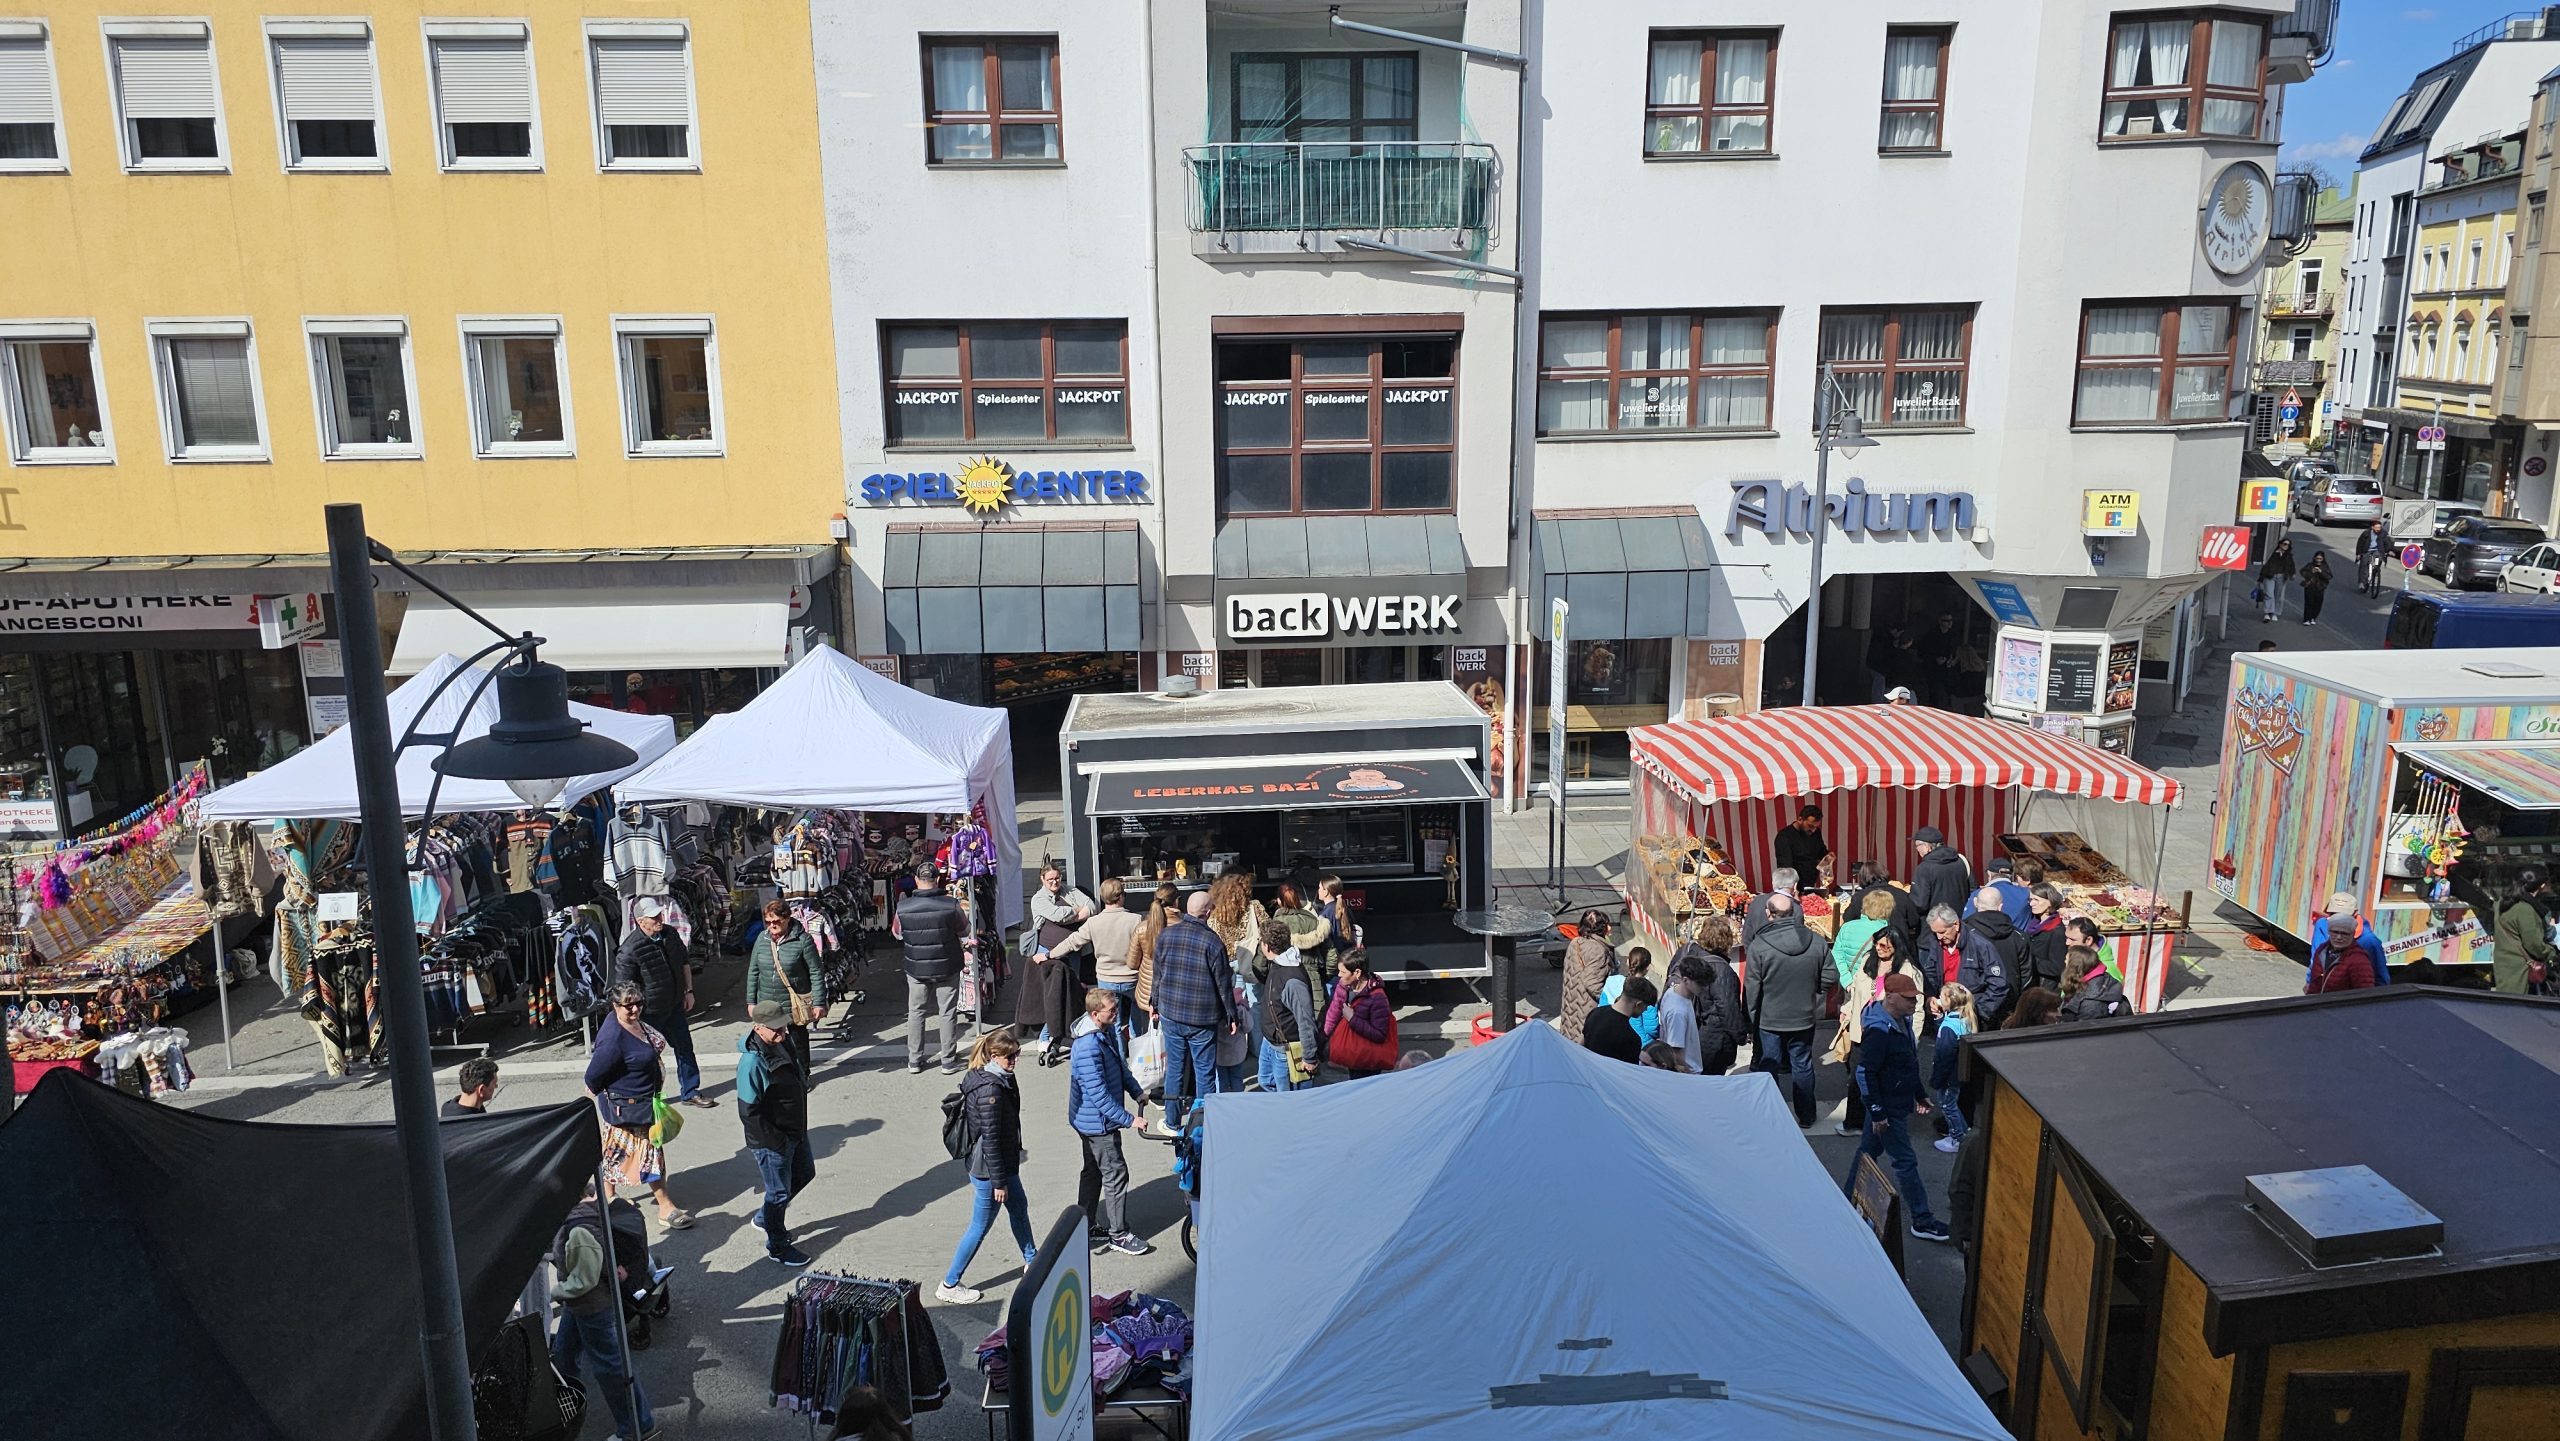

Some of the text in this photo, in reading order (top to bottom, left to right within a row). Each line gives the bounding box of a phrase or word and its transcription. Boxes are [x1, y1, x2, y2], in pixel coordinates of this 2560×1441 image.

[895, 390, 1121, 405] JACKPOT Spielcenter JACKPOT
[1224, 390, 1449, 406] JACKPOT Spielcenter JACKPOT
[1619, 402, 1657, 419] Juwelier
[1892, 396, 1960, 413] Juwelier Bacak
[861, 470, 1146, 500] SPIEL CENTER
[1724, 477, 1974, 535] Atrium
[2100, 495, 2131, 505] ATM
[2407, 510, 2421, 520] 20
[2203, 532, 2246, 566] illy
[2093, 554, 2104, 562] 34
[1457, 651, 1485, 660] back
[1711, 645, 1738, 655] back
[864, 660, 893, 670] back
[1184, 656, 1211, 665] back
[1456, 662, 1486, 671] WERK
[1709, 656, 1739, 665] WERK
[1183, 667, 1213, 675] WERK
[1133, 781, 1320, 798] LEBERKAS BAZI
[2386, 934, 2429, 954] EBRANNTE
[1052, 1294, 1073, 1390] H
